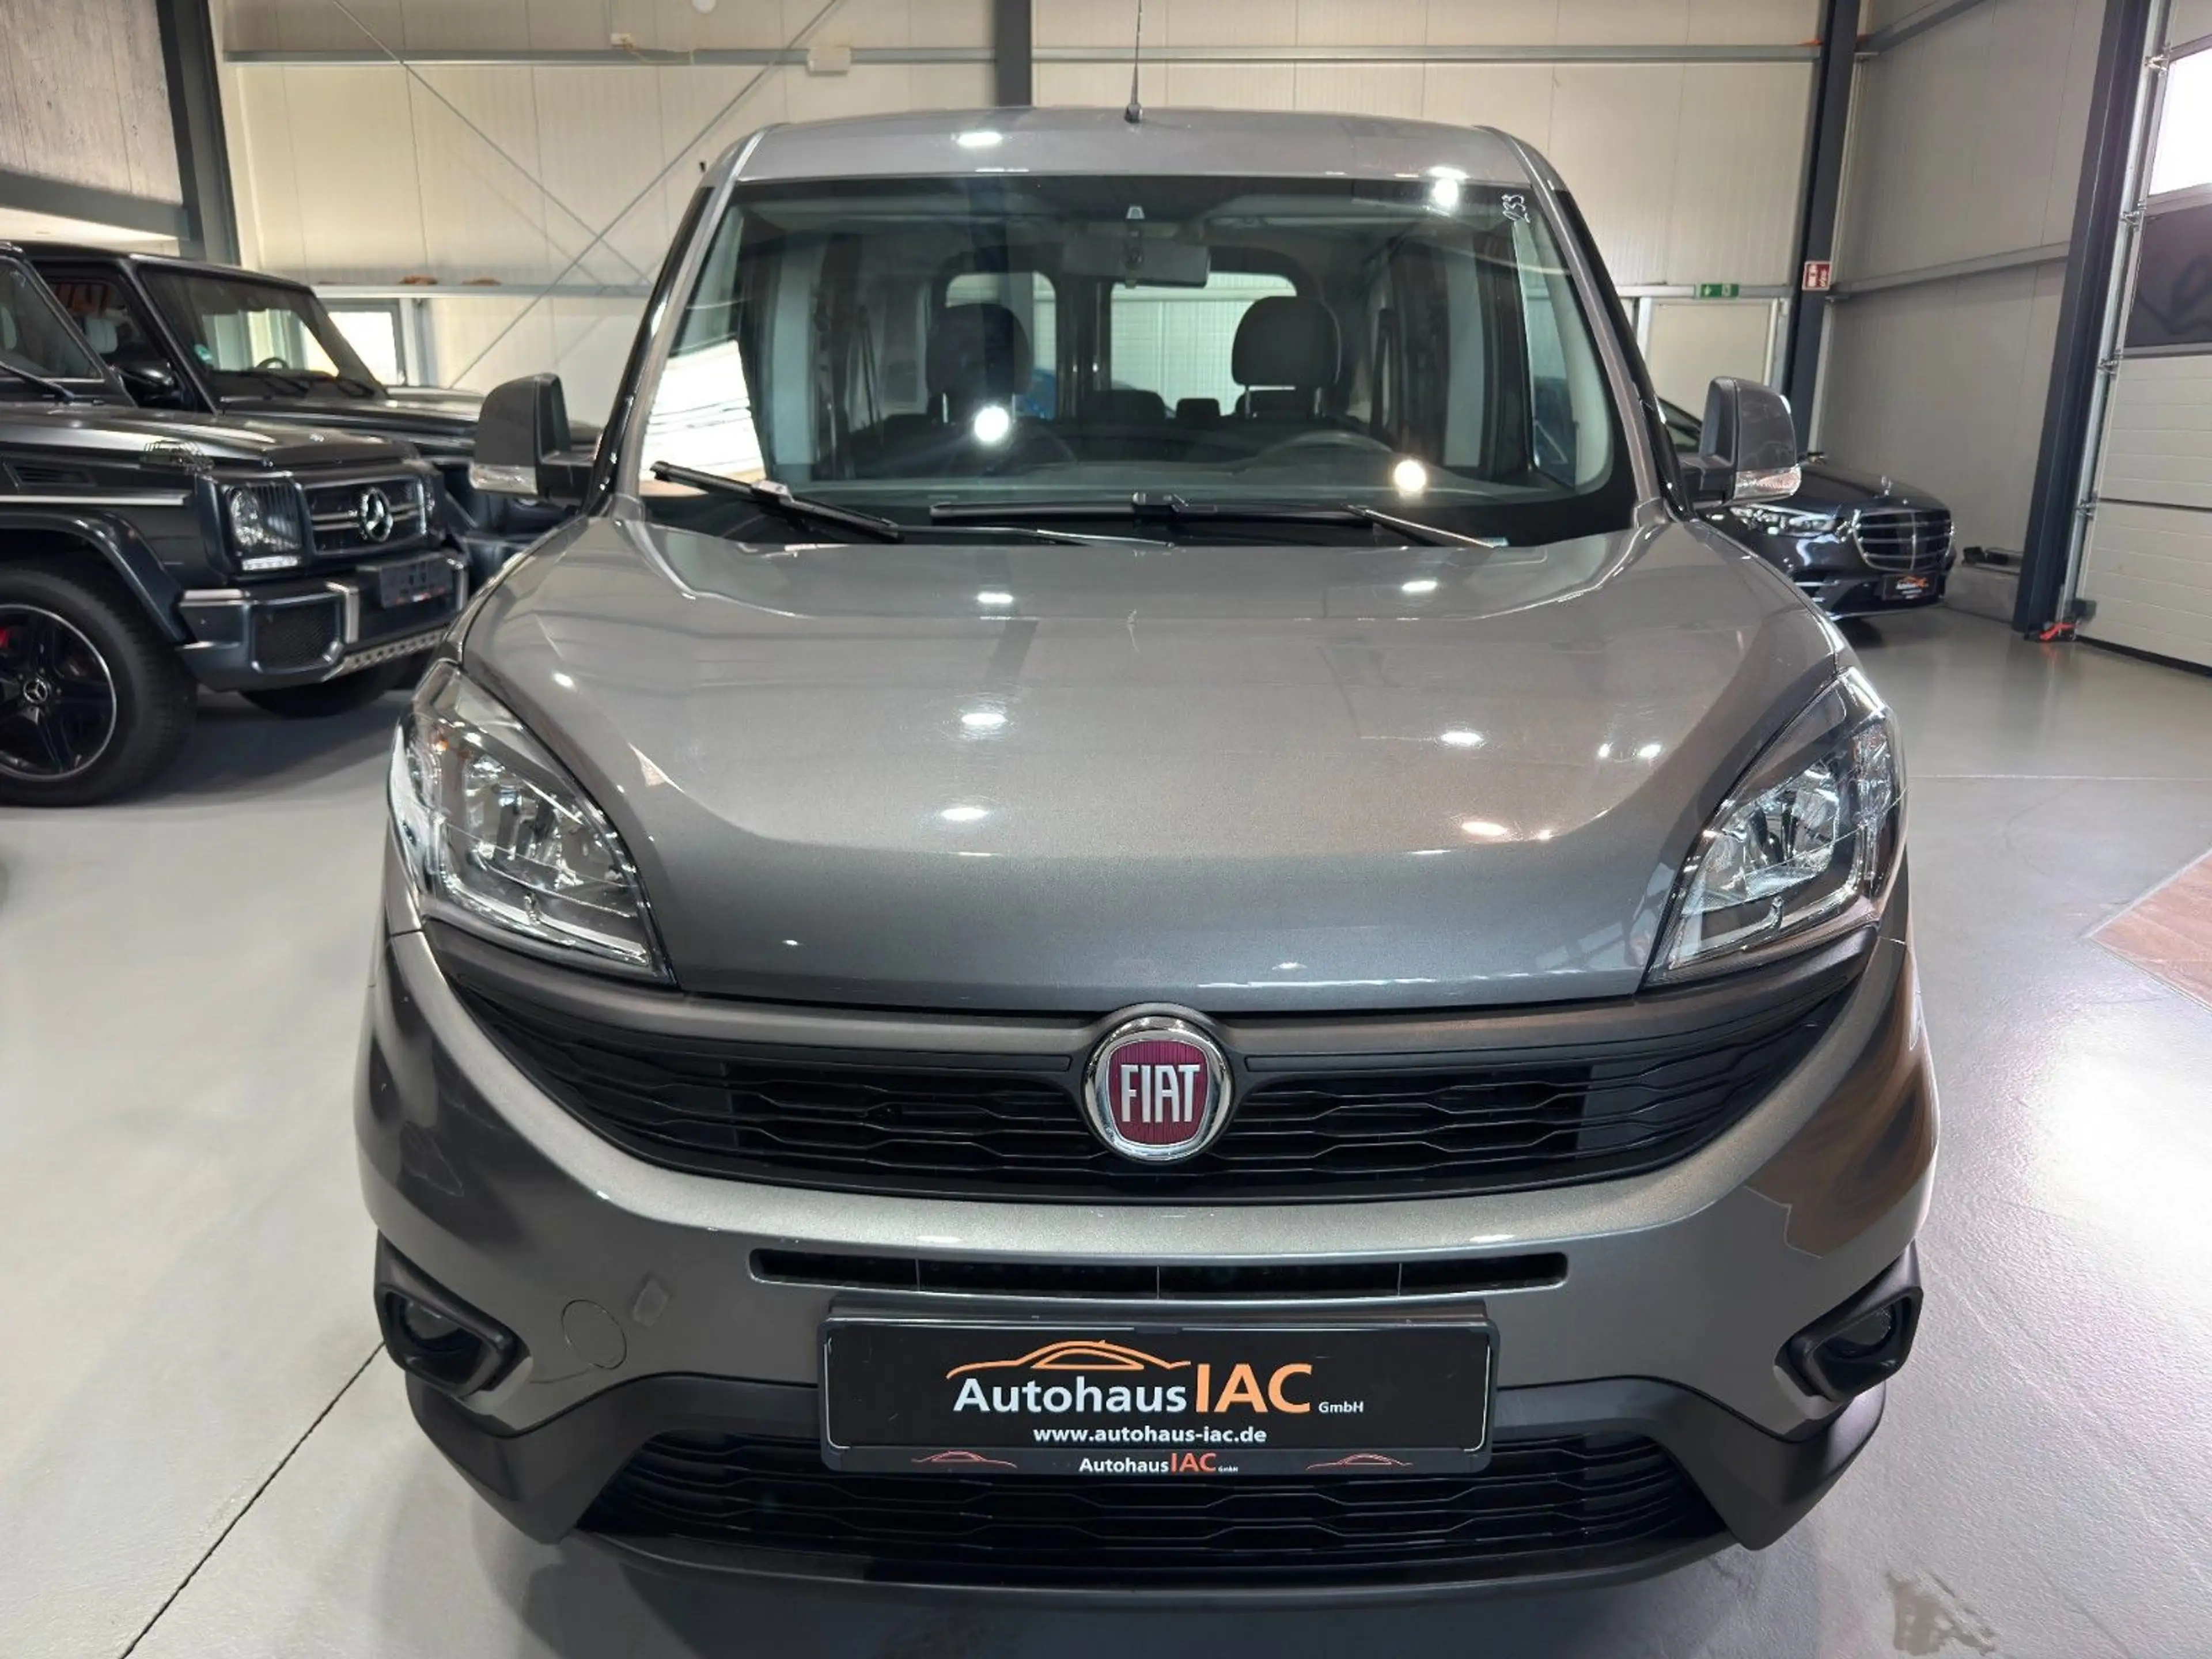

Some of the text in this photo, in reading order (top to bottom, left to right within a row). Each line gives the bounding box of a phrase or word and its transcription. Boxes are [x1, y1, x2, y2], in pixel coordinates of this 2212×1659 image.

[1121, 1064, 1200, 1123] FIAT
[1319, 1400, 1364, 1414] GmbH
[1033, 1425, 1267, 1443] www.autohaus-iac.de
